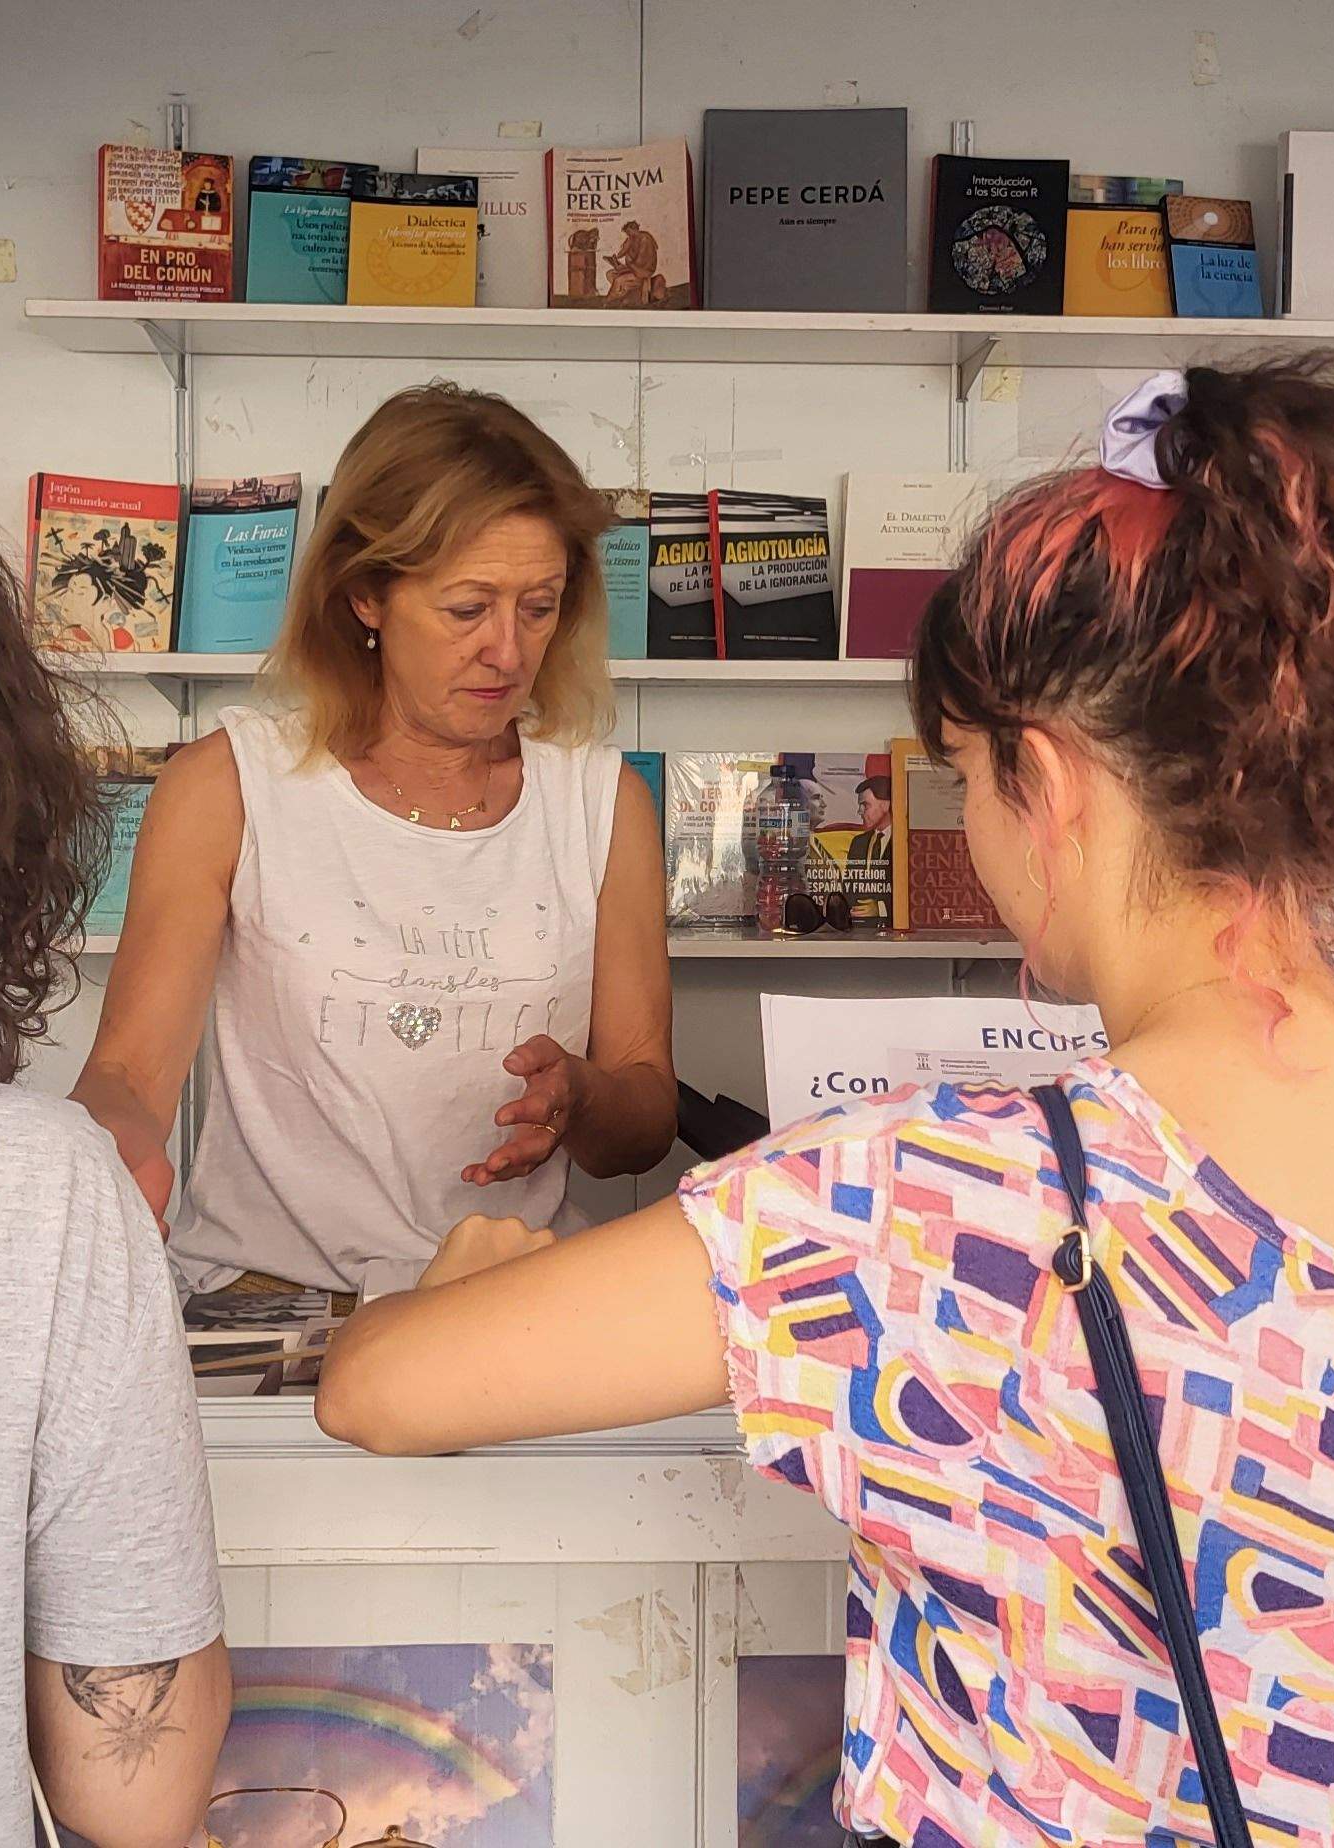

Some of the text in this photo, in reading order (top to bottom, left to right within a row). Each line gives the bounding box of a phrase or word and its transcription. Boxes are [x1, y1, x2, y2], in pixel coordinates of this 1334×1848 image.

[567, 166, 663, 191] LATINVM
[972, 174, 1032, 187] Introducción
[567, 192, 631, 210] PER SE
[730, 179, 884, 205] PEPE CERDÁ
[407, 215, 466, 227] Dialéctica
[141, 249, 196, 266] EN PRO
[124, 264, 212, 283] DEL COMÚN
[49, 481, 80, 495] Japón
[56, 494, 67, 503] el
[69, 497, 107, 508] mundo
[110, 501, 142, 511] actual
[224, 524, 289, 543] Las Furias
[725, 533, 827, 564] AGNOTOLOGÍA
[752, 558, 828, 577] LA PRODUCCIÓN
[739, 573, 828, 592] DE LA IGNORANCIA
[842, 868, 886, 880] EXTERIOR
[844, 882, 850, 892] Y
[853, 882, 891, 893] FRANCIA
[399, 923, 494, 959] LA TÊTE
[809, 1071, 889, 1098] ¿Con
